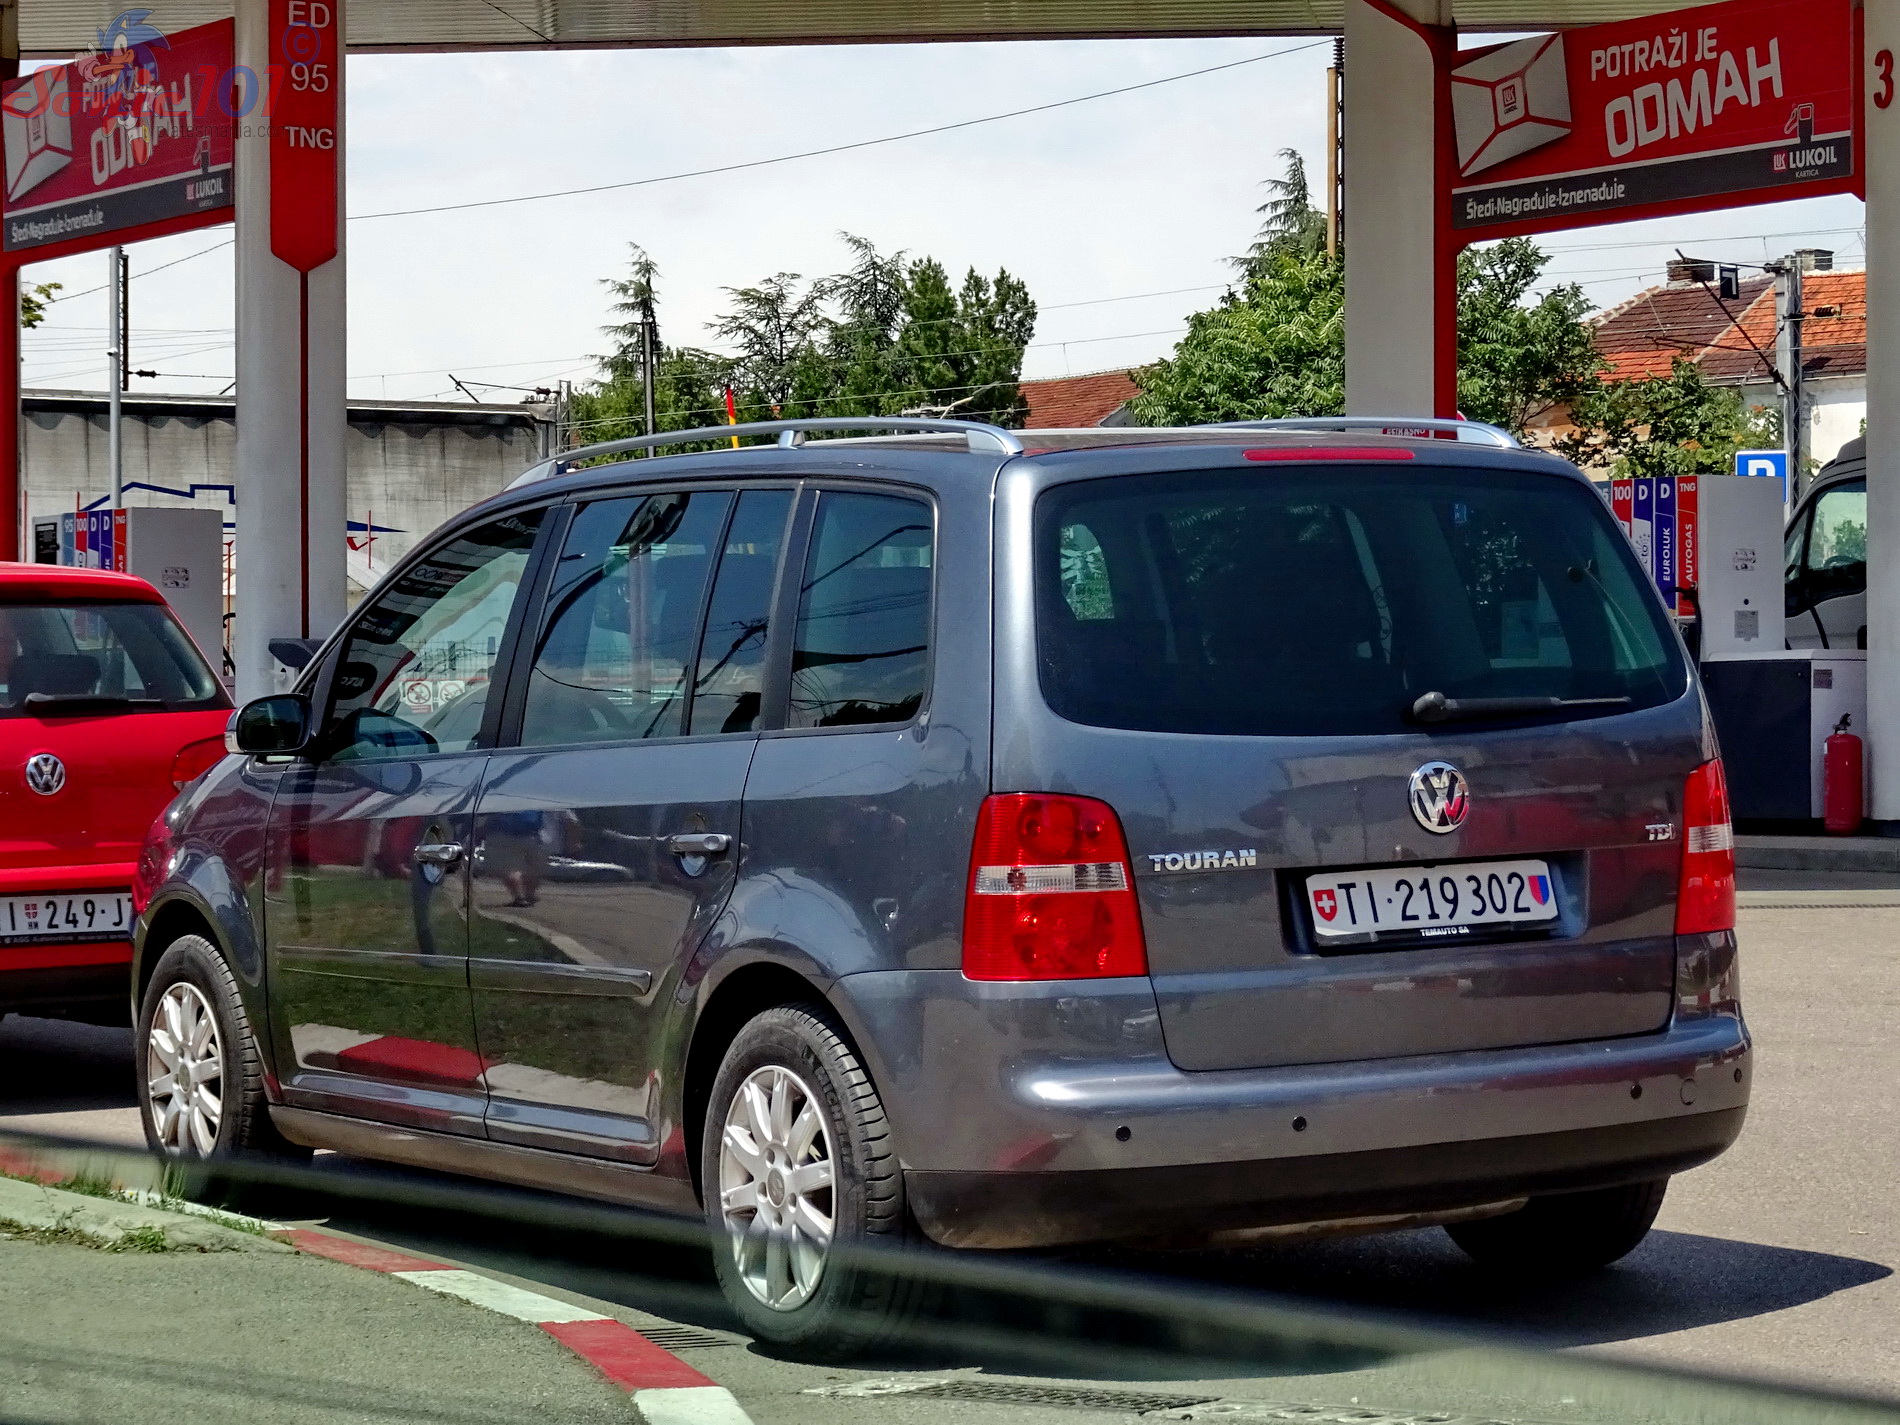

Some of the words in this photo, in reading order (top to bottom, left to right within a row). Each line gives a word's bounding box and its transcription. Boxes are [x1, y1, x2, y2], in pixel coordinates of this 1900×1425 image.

[289, 1, 330, 28] ED
[1591, 27, 1688, 82] POTRAŽI
[1694, 26, 1718, 62] JE
[291, 62, 329, 92] 95
[1873, 50, 1894, 109] 3
[1605, 37, 1784, 158] ODMAH
[285, 126, 334, 149] TNG
[1789, 146, 1837, 169] LUKOIL
[1795, 169, 1819, 178] KARTICA
[195, 177, 224, 198] LUKOIL
[1613, 485, 1632, 501] 100
[1638, 484, 1648, 501] D
[1660, 483, 1671, 499] D
[1679, 482, 1696, 493] TNG
[64, 518, 74, 533] 95
[76, 517, 87, 532] 100
[90, 516, 97, 532] D
[103, 515, 110, 531] D
[1662, 527, 1671, 581] EUROLUK
[1685, 523, 1693, 582] AUTOGAS
[1148, 849, 1257, 871] TOURAN
[1420, 927, 1458, 936] TEMAUTO
[1458, 926, 1470, 934] SA
